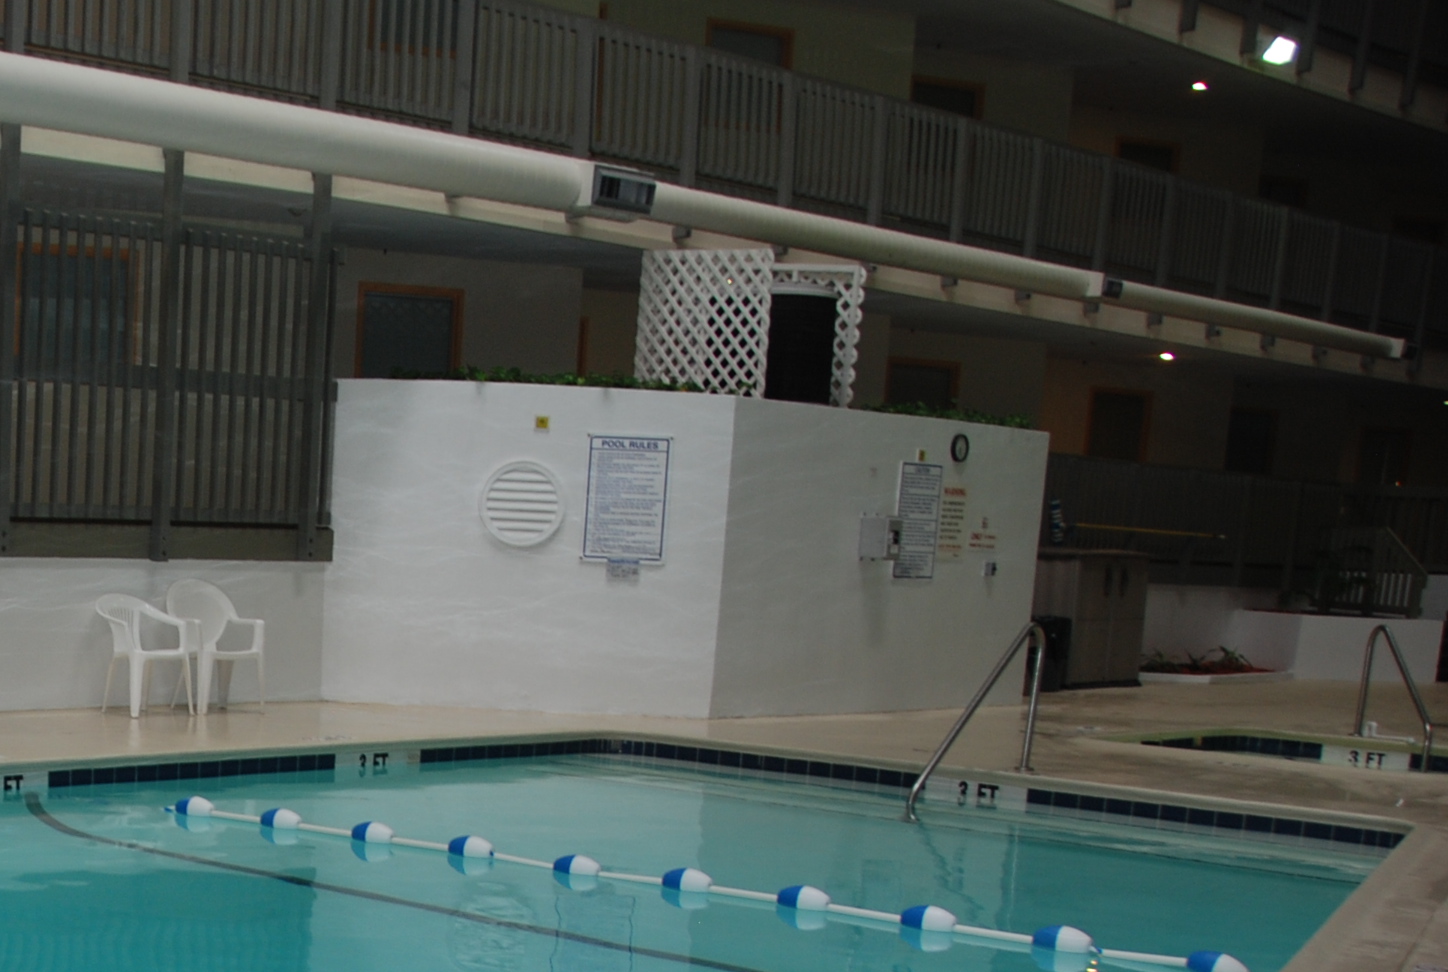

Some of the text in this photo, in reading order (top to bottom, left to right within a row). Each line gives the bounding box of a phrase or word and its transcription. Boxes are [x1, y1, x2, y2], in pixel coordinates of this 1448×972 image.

[601, 440, 659, 450] POOL RULES
[373, 753, 389, 766] FT
[1348, 750, 1385, 767] 3 FT
[3, 775, 23, 791] FT
[977, 783, 999, 798] FT
